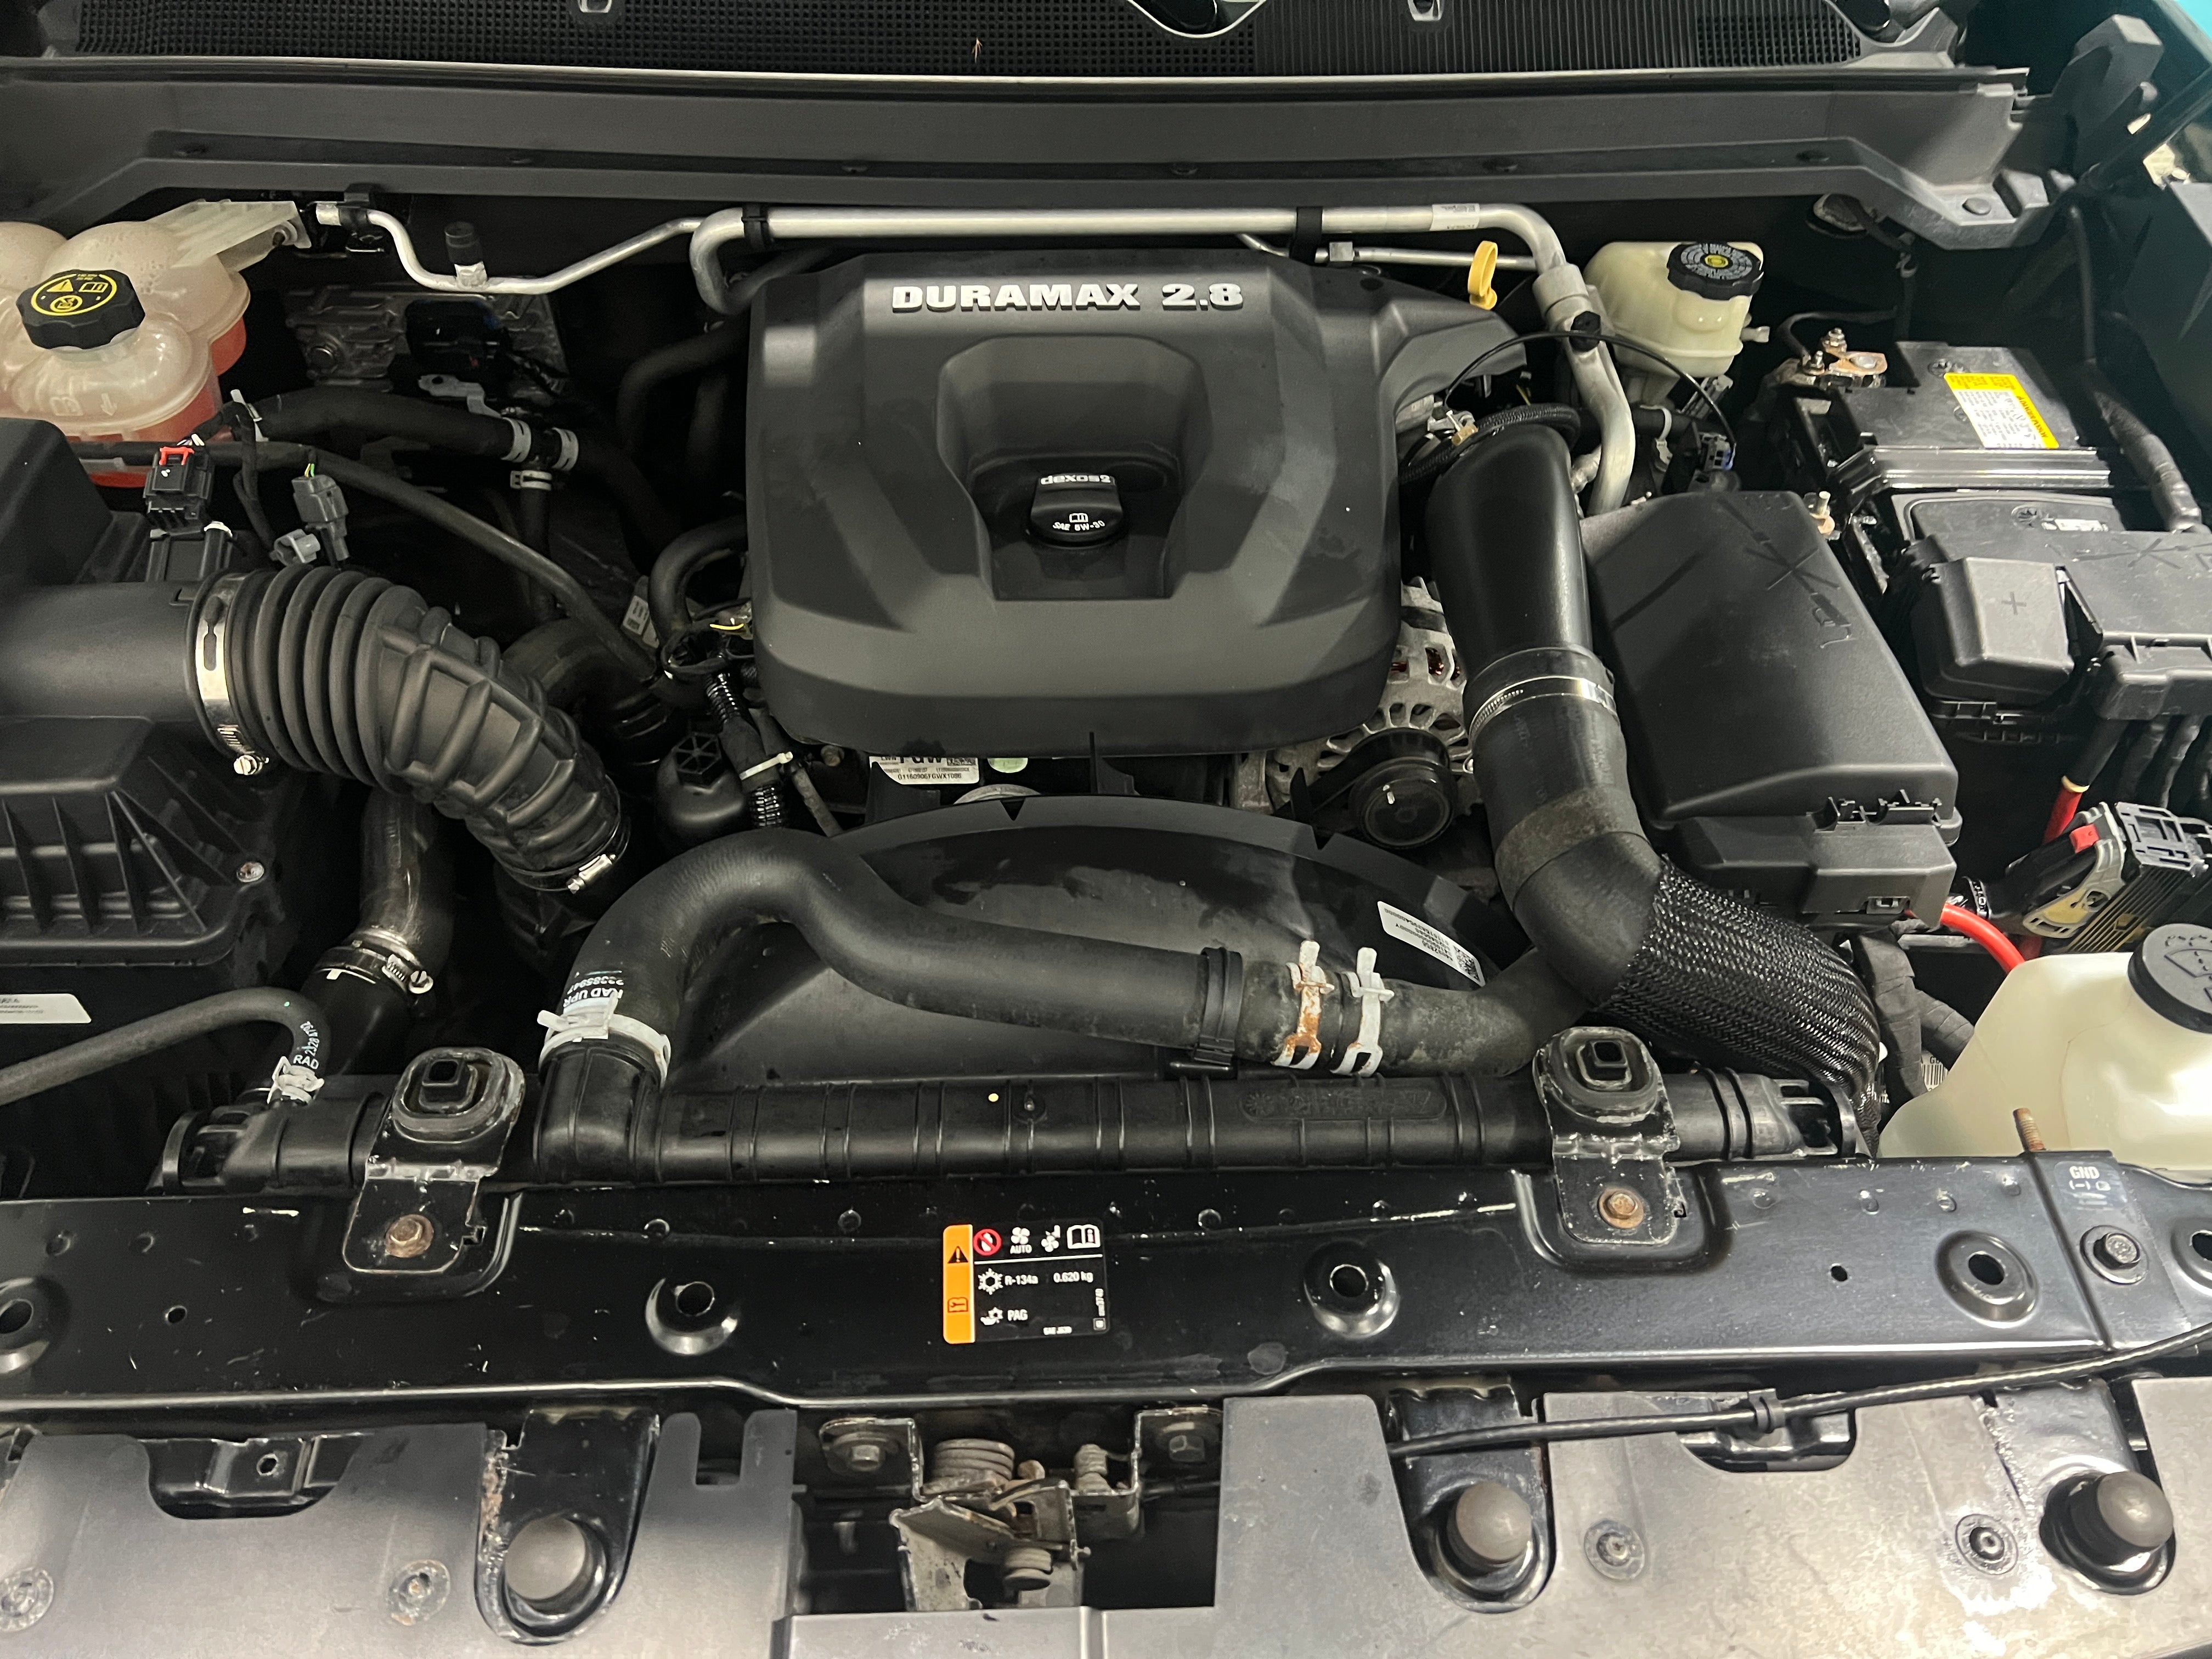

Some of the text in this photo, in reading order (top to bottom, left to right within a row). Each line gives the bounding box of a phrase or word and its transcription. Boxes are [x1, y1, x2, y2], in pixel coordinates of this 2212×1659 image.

[892, 283, 1243, 312] DURAMAX 2.8
[1041, 475, 1111, 484] dexos2
[1053, 522, 1070, 531] SAE
[563, 989, 588, 1007] UPR
[294, 1054, 319, 1069] RAD
[2069, 1166, 2100, 1179] GND
[1010, 1244, 1032, 1254] AUTO
[1005, 1271, 1093, 1285] R-134a 0.620 kg
[1007, 1309, 1028, 1321] PAG
